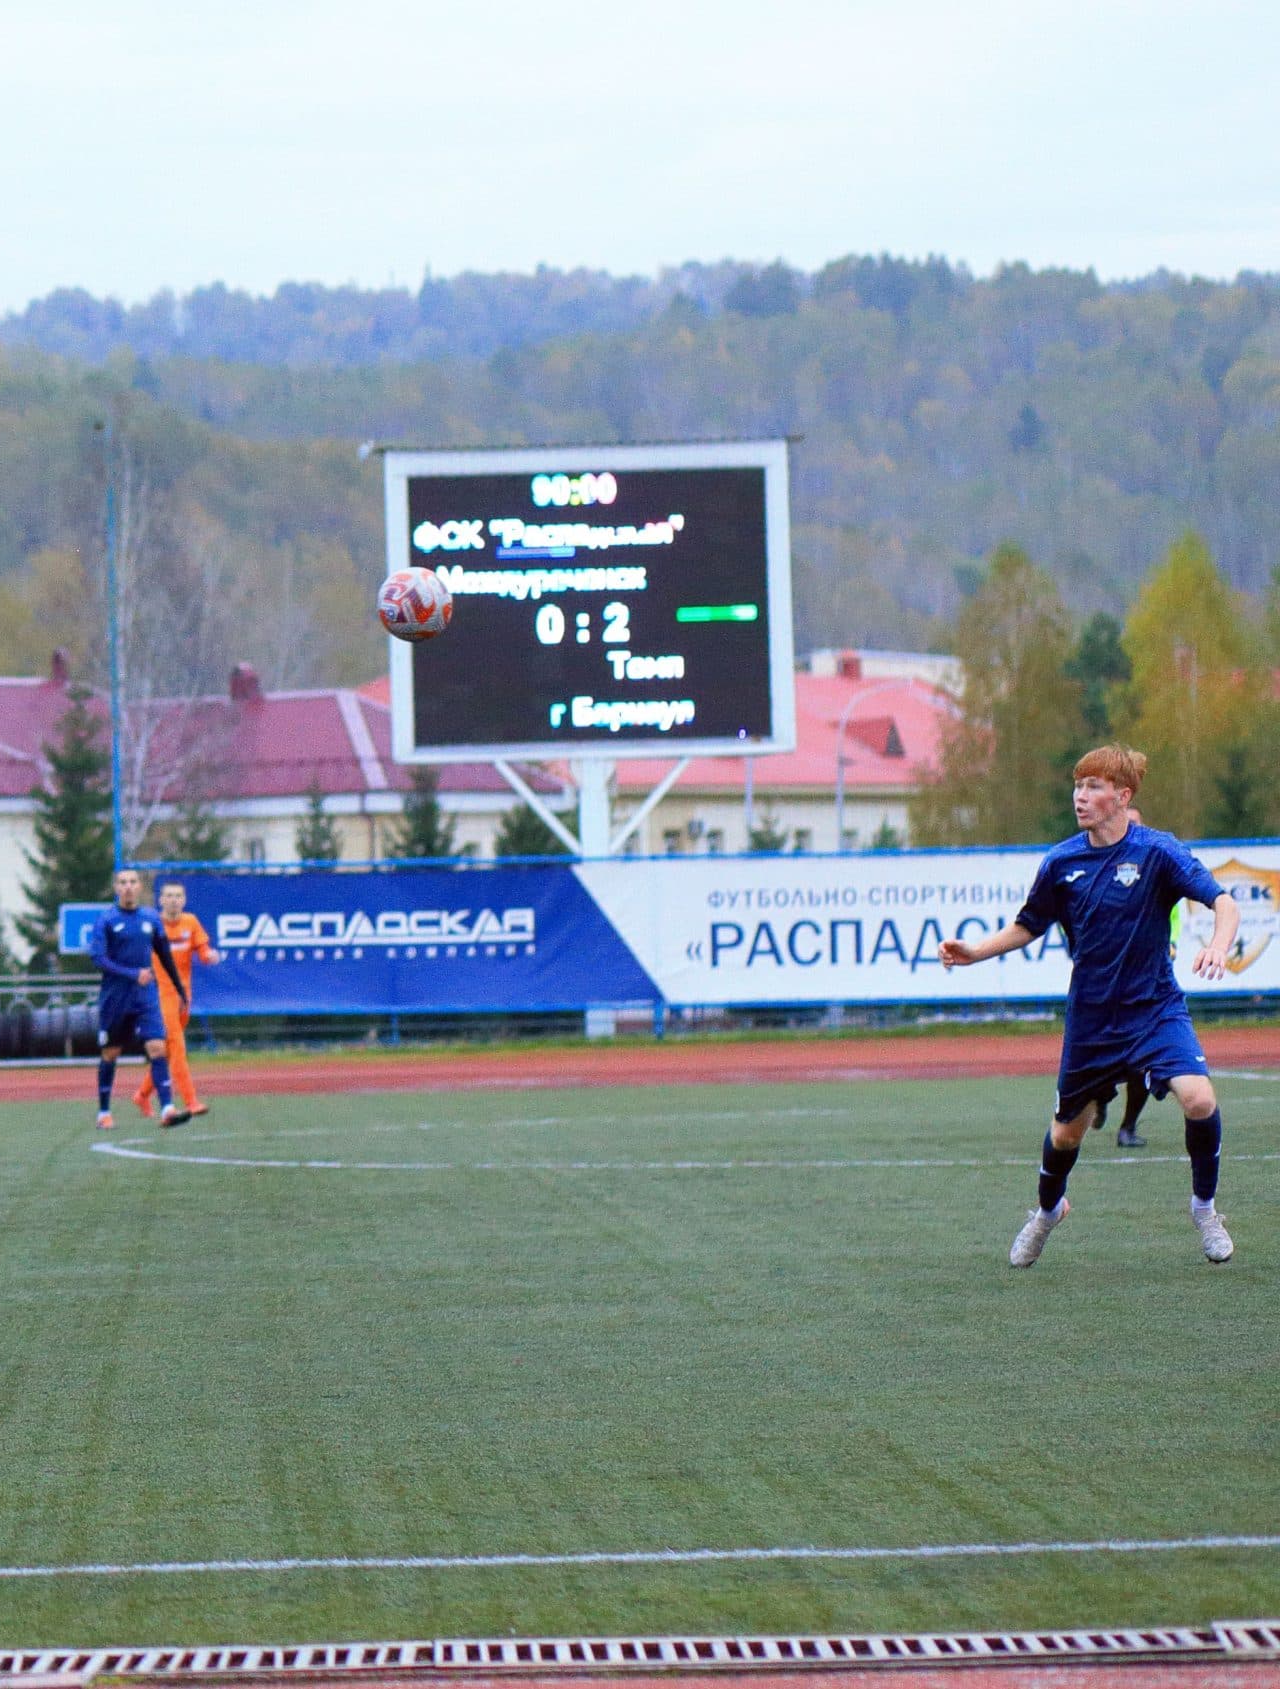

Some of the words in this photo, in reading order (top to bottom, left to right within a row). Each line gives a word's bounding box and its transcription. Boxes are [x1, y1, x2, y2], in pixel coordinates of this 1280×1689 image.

[413, 520, 485, 551] ФСК
[536, 603, 565, 645] 0
[602, 602, 631, 644] 2
[707, 883, 1025, 910] ФУТБОЛЬНО-СПОРТИВНЫ
[217, 908, 535, 947] РАСПАДСКАЯ
